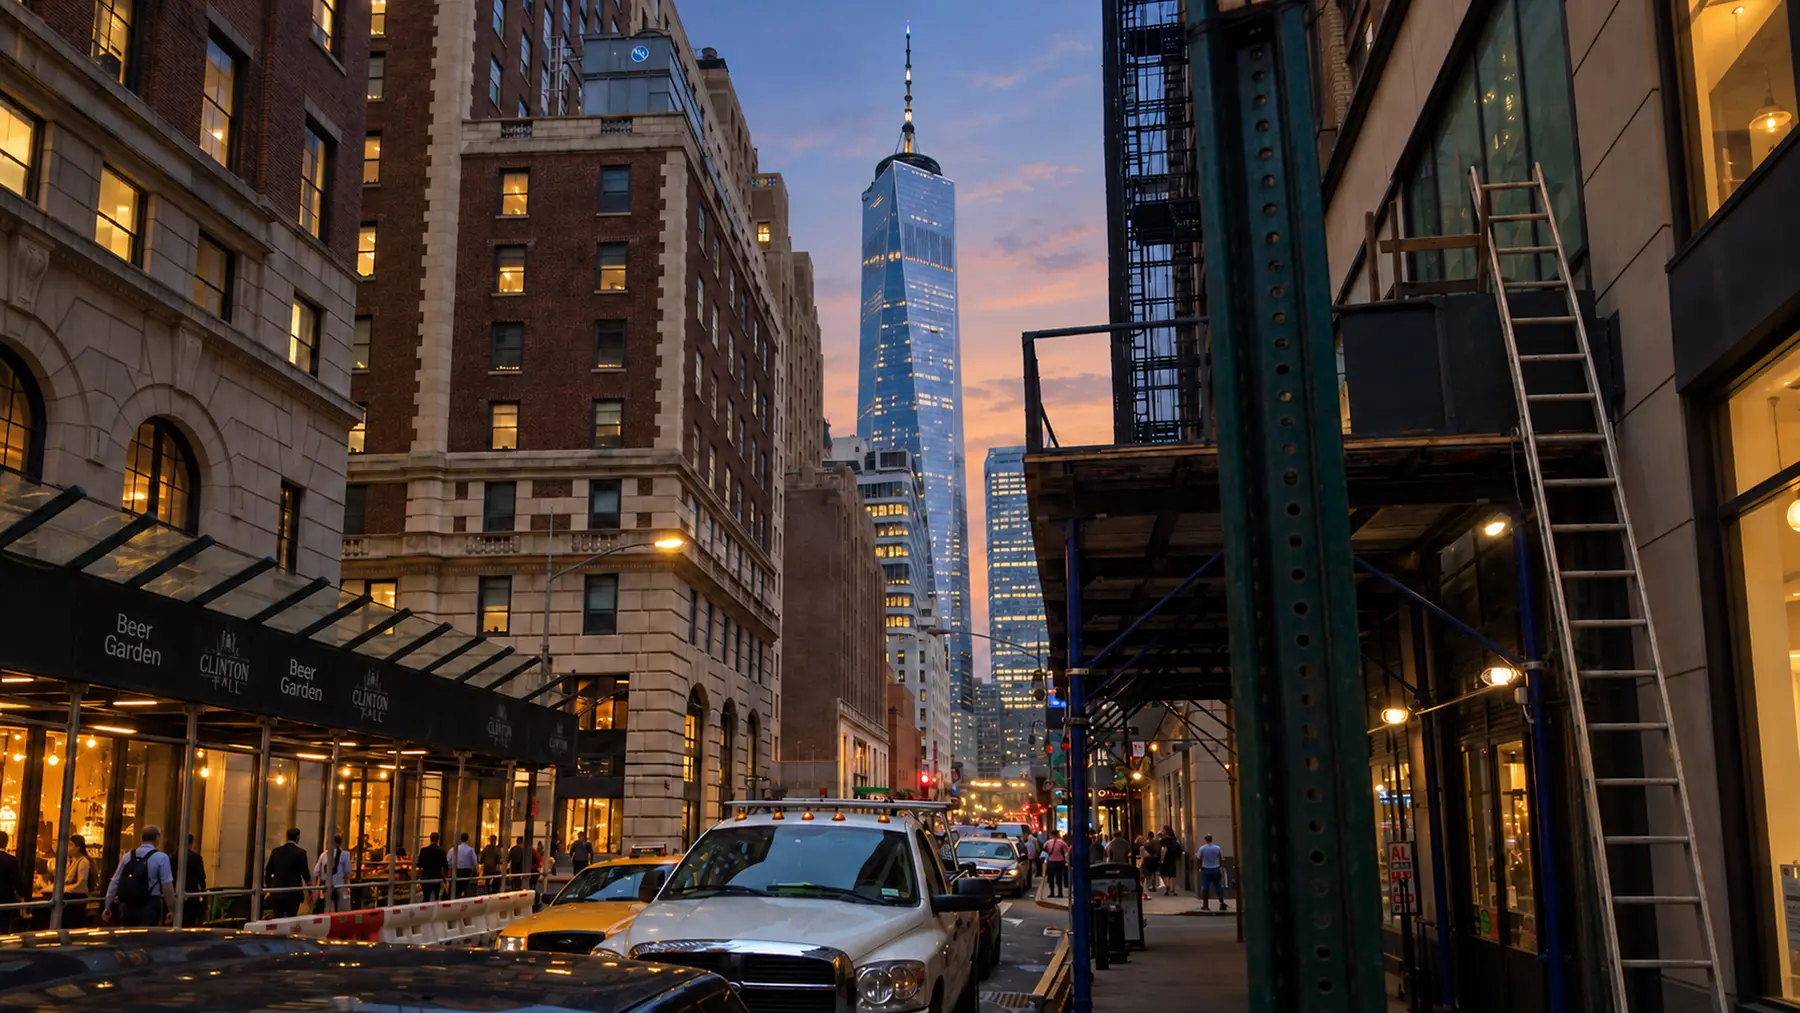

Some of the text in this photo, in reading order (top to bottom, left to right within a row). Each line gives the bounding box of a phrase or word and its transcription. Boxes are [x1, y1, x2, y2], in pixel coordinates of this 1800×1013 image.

[117, 612, 153, 640] Beer
[104, 634, 162, 666] Garden
[200, 653, 249, 682] CLINTON
[289, 658, 317, 681] Beer
[280, 676, 323, 702] Garden
[352, 689, 389, 711] CLINTON
